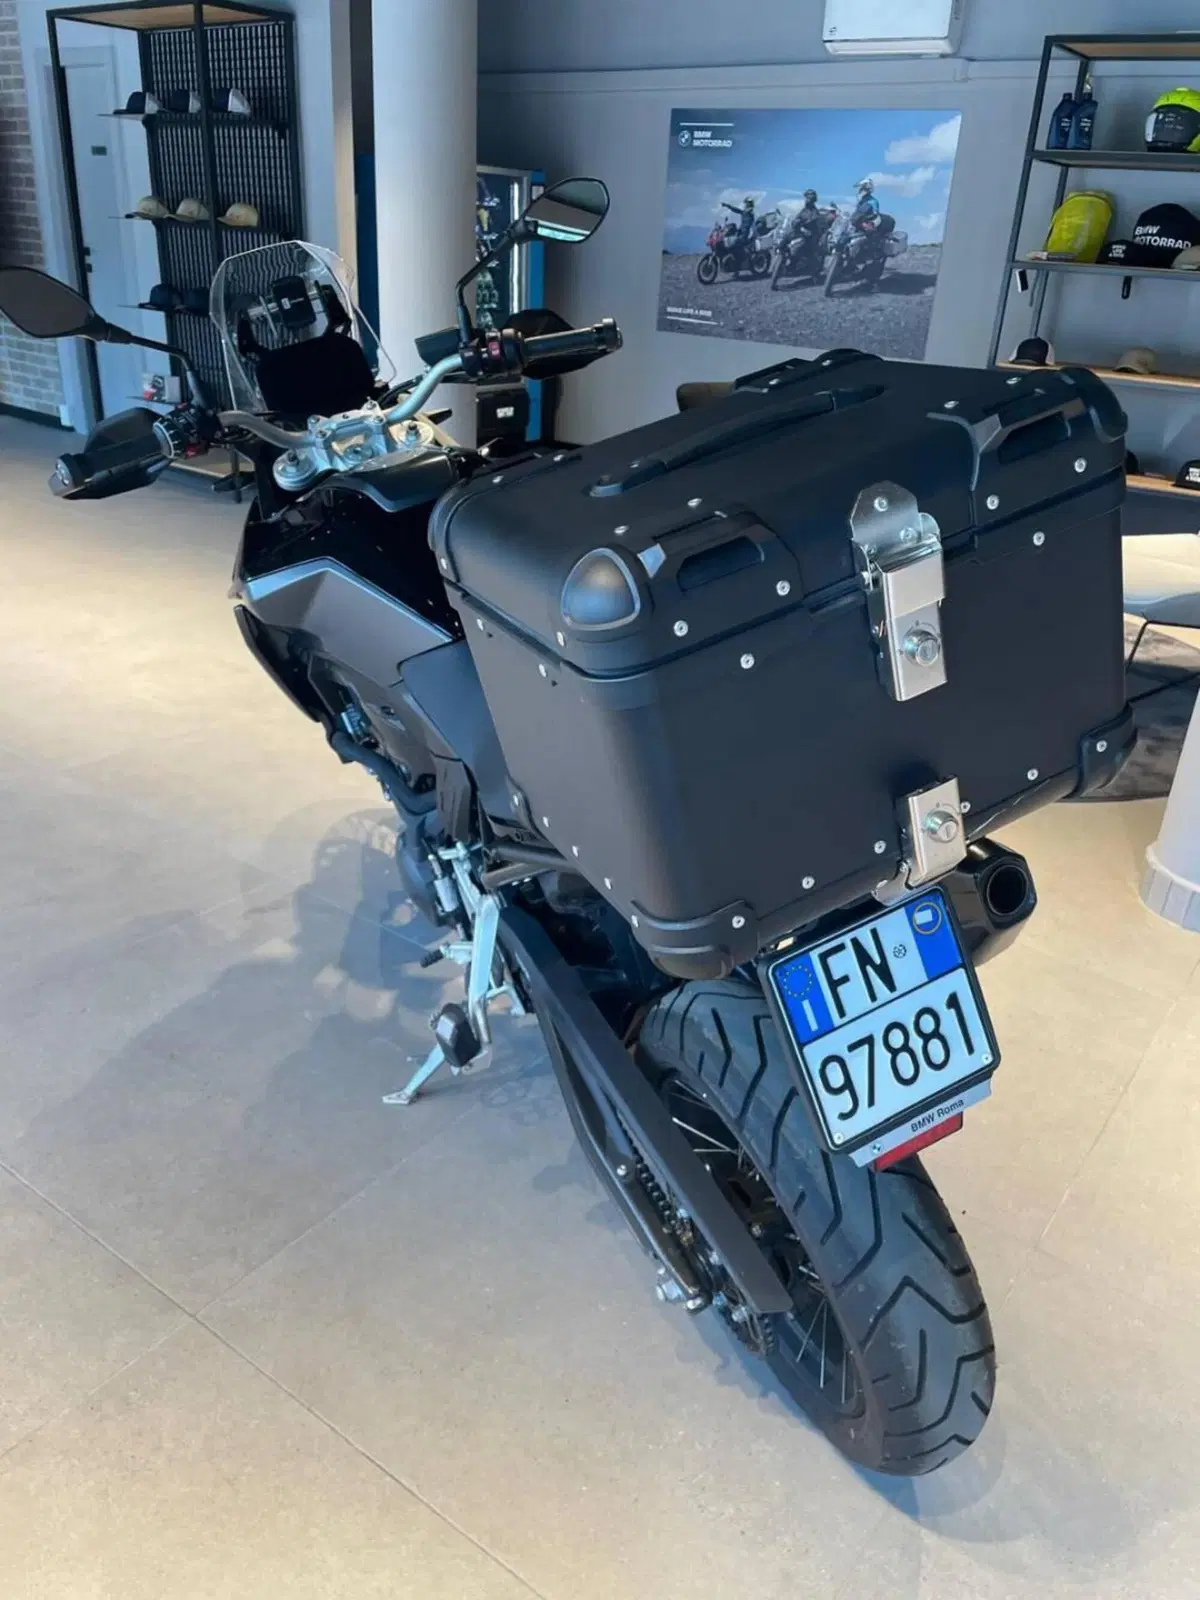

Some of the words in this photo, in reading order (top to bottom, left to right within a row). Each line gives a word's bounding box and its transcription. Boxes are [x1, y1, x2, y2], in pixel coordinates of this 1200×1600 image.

[818, 927, 897, 1018] FN
[818, 991, 975, 1120] 97881
[910, 1112, 935, 1132] BMW
[936, 1099, 965, 1118] Roma
